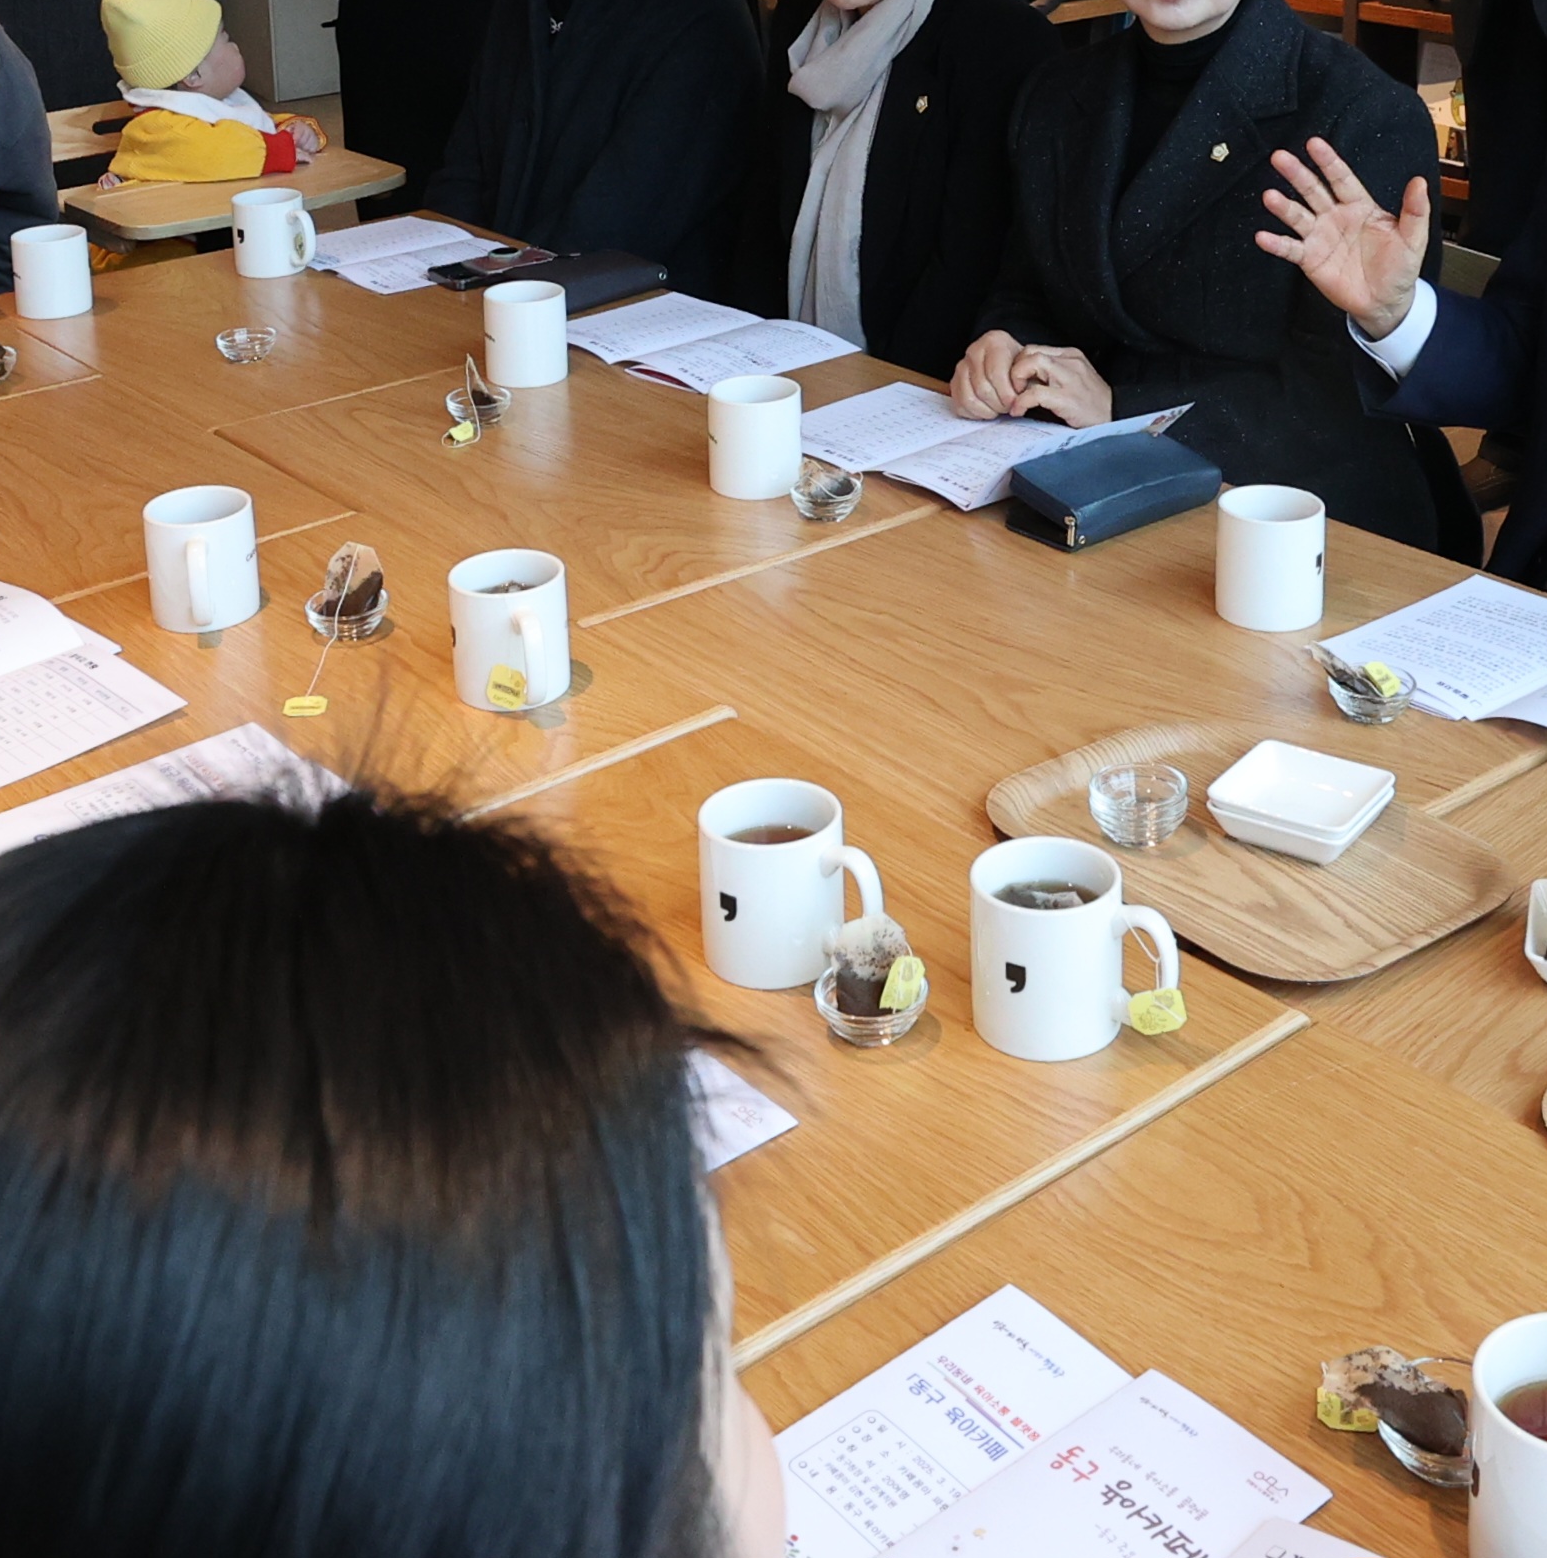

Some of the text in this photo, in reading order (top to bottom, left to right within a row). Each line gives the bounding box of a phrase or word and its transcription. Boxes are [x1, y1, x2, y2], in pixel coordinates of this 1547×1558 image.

[935, 1354, 974, 1386] 우리동네
[943, 1405, 1010, 1463] 육아카페
[1049, 1445, 1100, 1483] 동구
